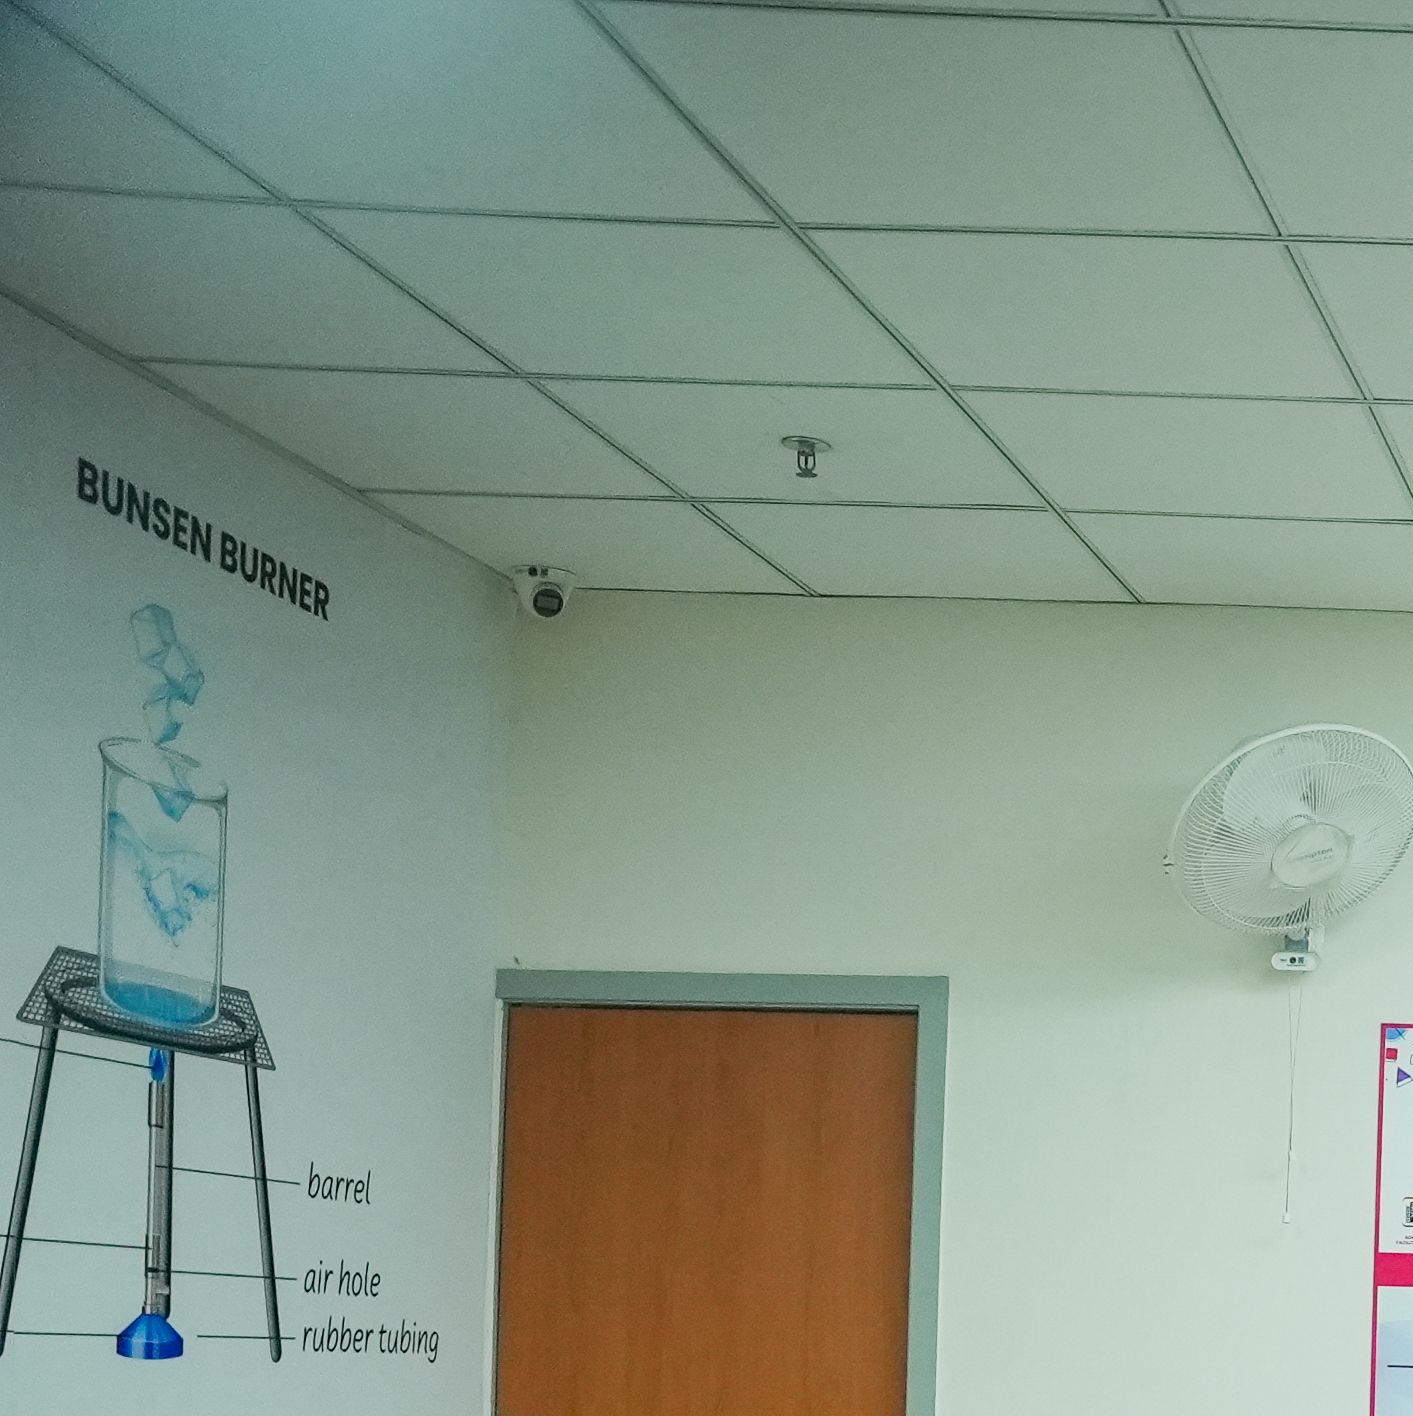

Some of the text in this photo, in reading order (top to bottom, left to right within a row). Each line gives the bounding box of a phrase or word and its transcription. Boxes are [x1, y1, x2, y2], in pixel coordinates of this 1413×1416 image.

[77, 456, 331, 622] BUNSEN BURNER
[308, 1161, 371, 1205] barrel
[304, 1259, 381, 1297] air hole
[302, 1315, 440, 1363] rubber tubing
